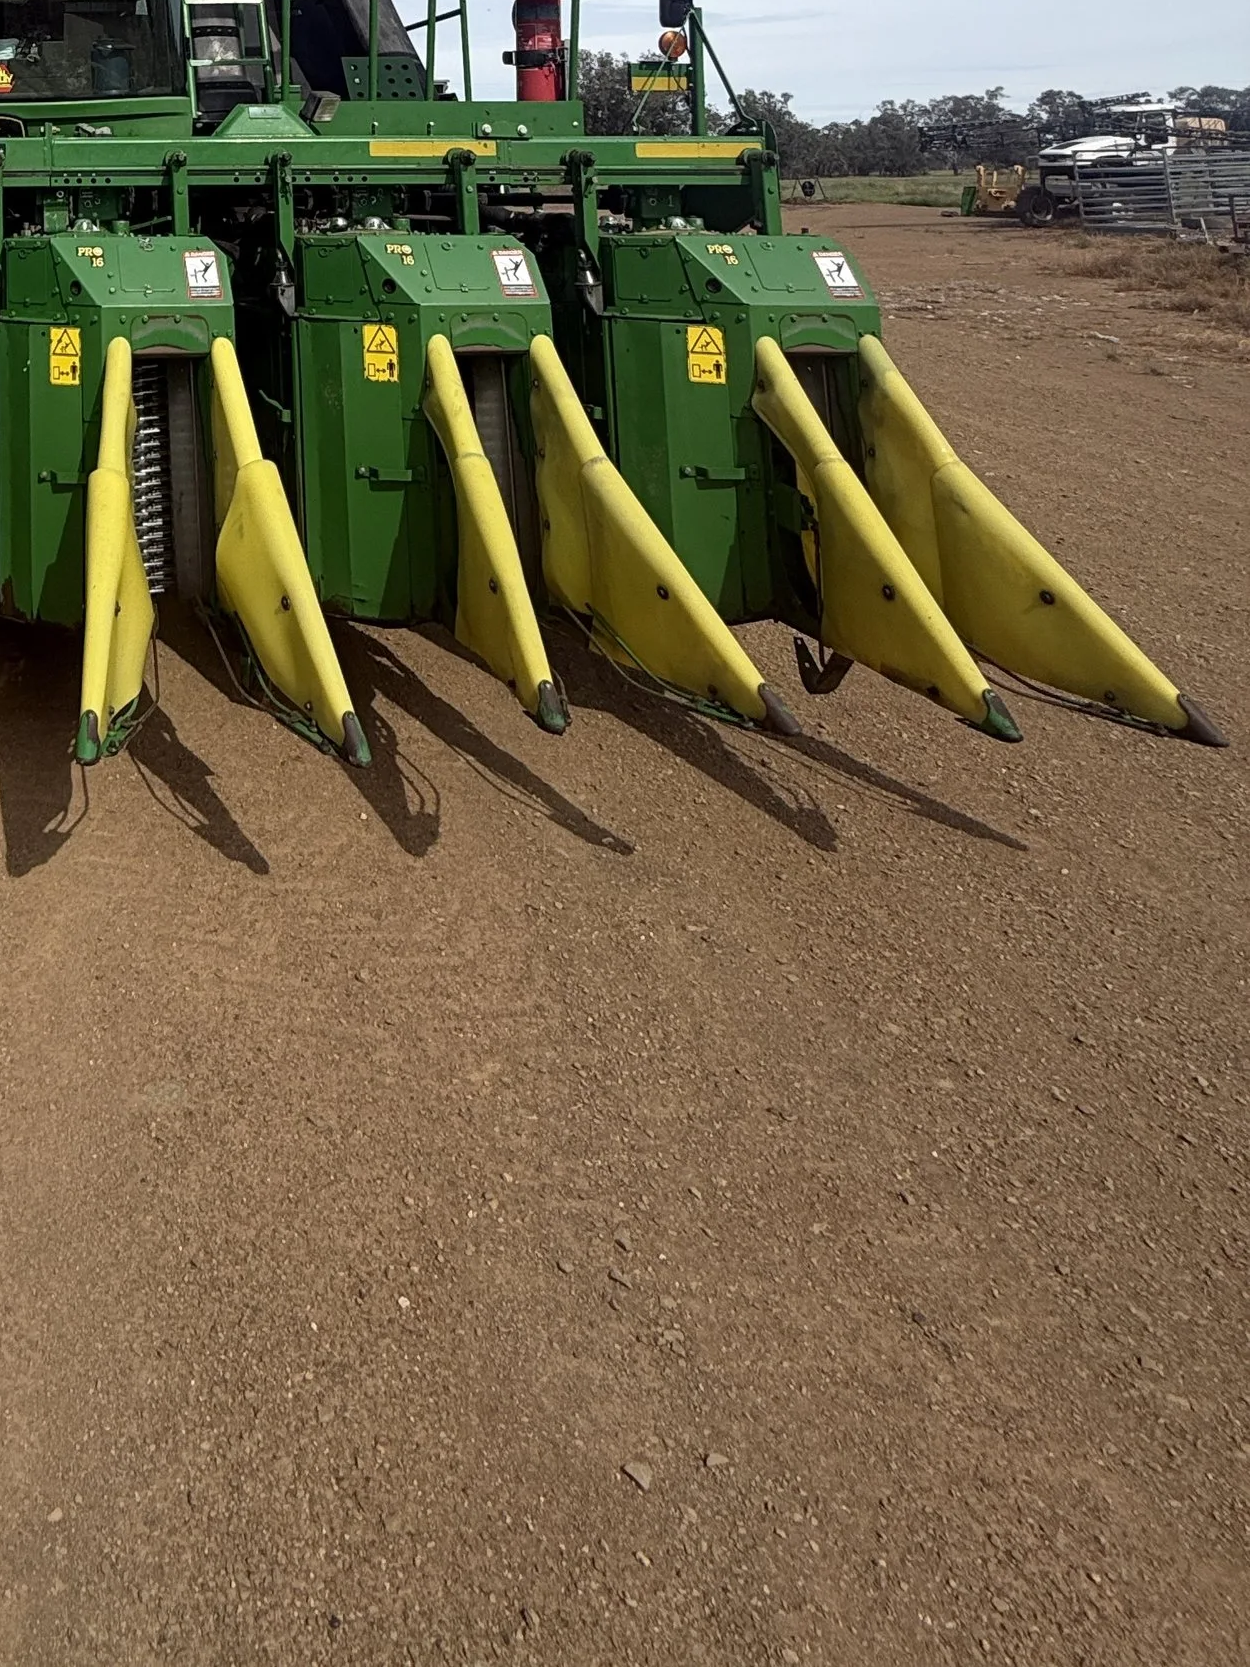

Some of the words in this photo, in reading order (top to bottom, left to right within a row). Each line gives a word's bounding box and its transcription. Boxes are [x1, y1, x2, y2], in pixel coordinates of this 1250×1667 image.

[77, 246, 104, 257] PRO
[385, 244, 412, 254] PRO
[706, 244, 734, 254] PRO
[91, 257, 104, 267] 16
[402, 255, 415, 265] 16
[725, 255, 739, 265] 16
